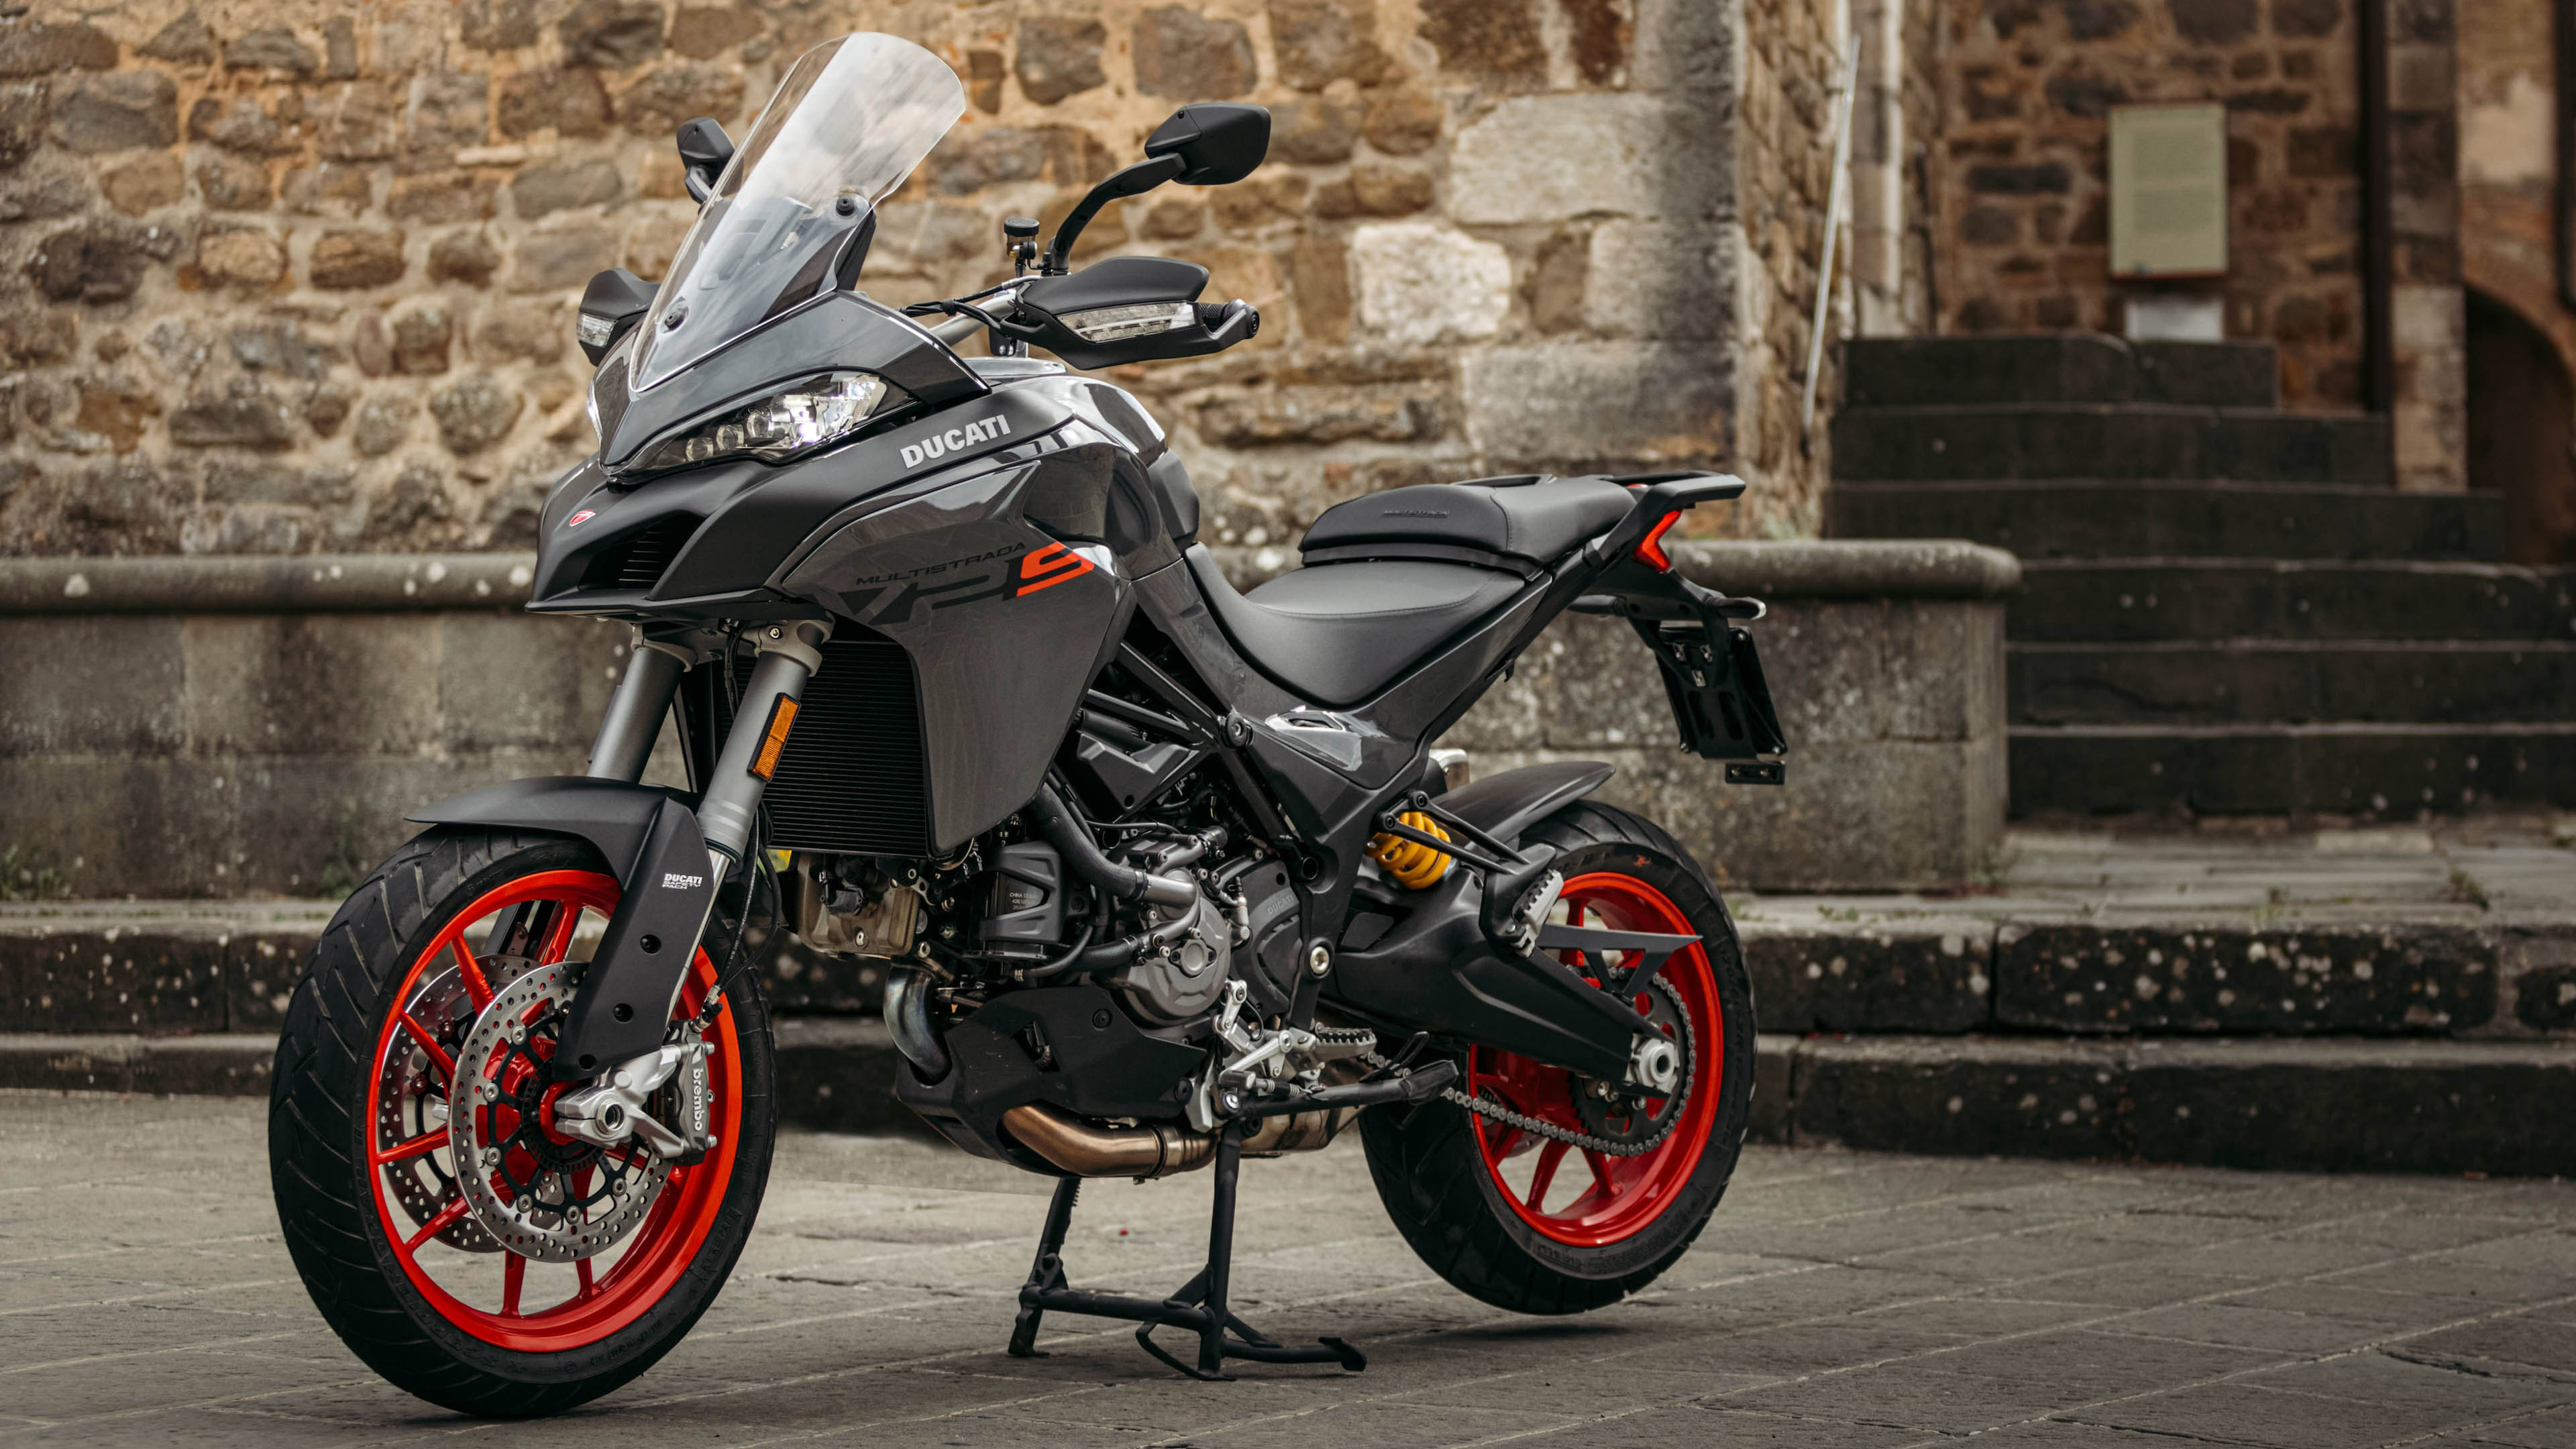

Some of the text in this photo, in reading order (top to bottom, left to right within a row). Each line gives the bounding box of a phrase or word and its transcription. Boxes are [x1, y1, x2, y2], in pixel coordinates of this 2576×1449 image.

[900, 415, 1011, 469] DUCATI
[856, 541, 1026, 586] MULTISTRADA
[1016, 541, 1095, 598] S
[664, 873, 703, 884] DUCATI
[1267, 894, 1294, 914] DUCATI
[693, 1068, 705, 1131] brembo
